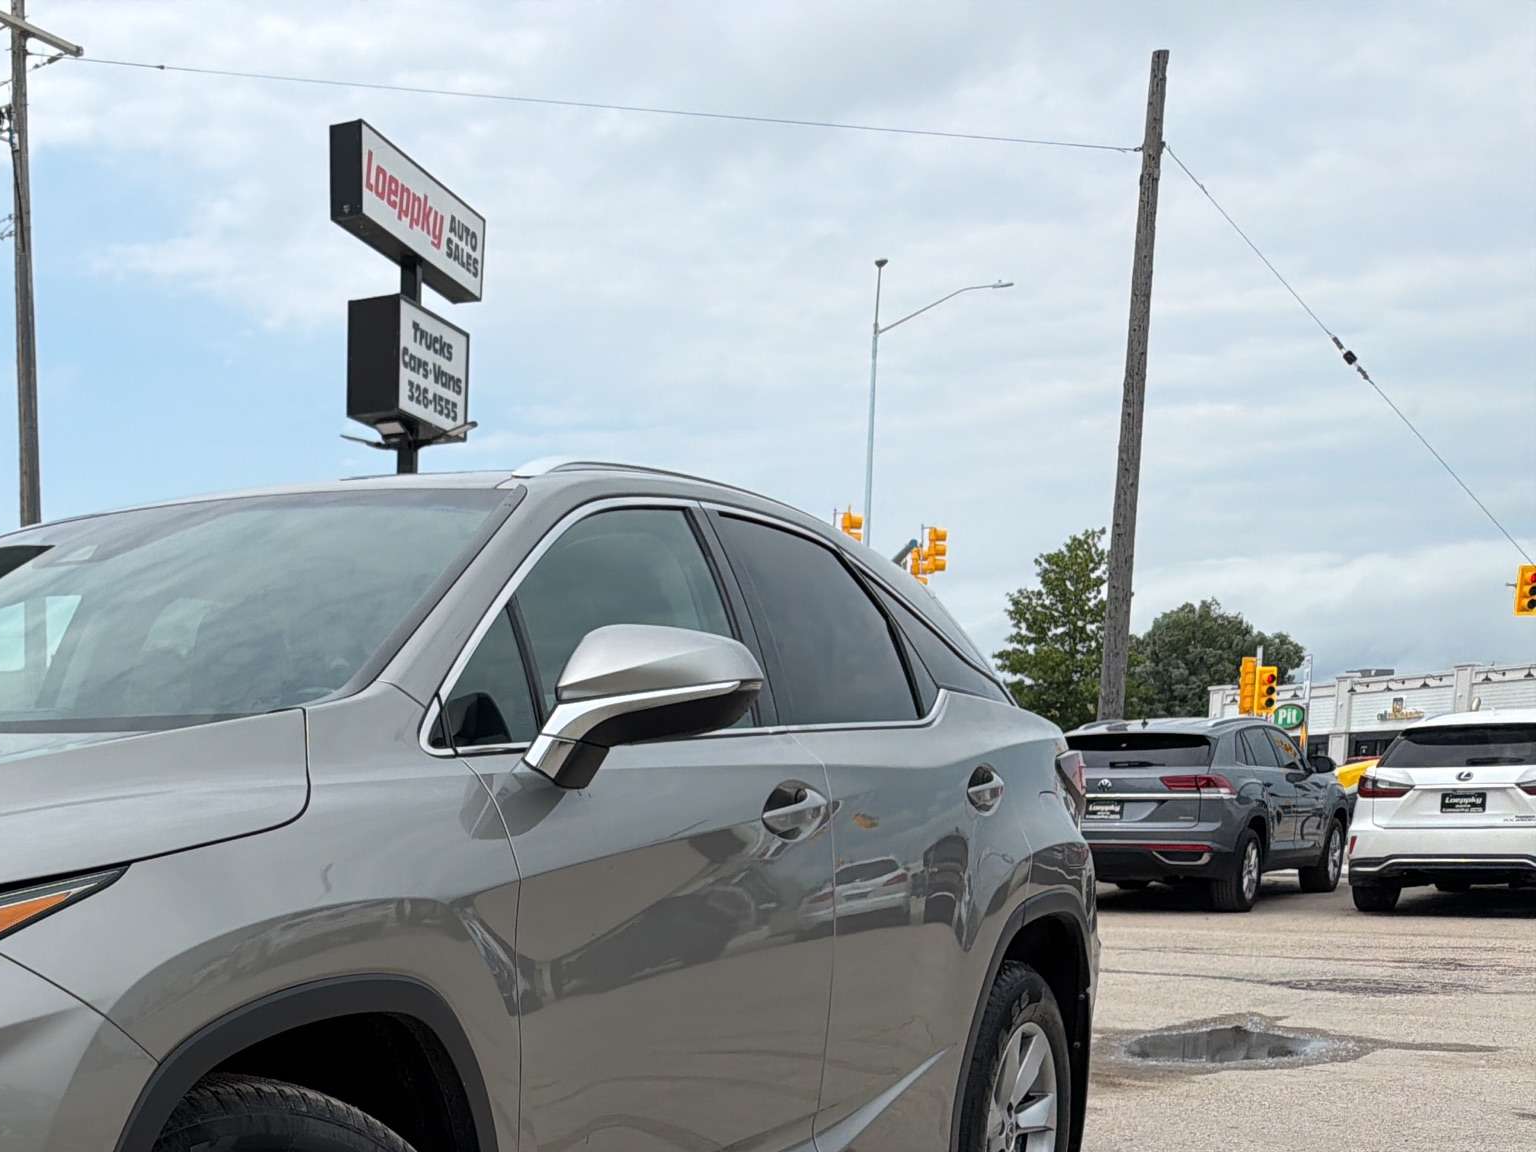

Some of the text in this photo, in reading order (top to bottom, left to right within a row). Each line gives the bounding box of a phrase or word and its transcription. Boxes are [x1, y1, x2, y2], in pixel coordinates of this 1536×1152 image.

[365, 149, 444, 250] Loeppky
[449, 214, 478, 253] AUTO
[446, 237, 479, 279] SALES
[412, 320, 453, 362] Trucks
[1277, 708, 1298, 725] Pit
